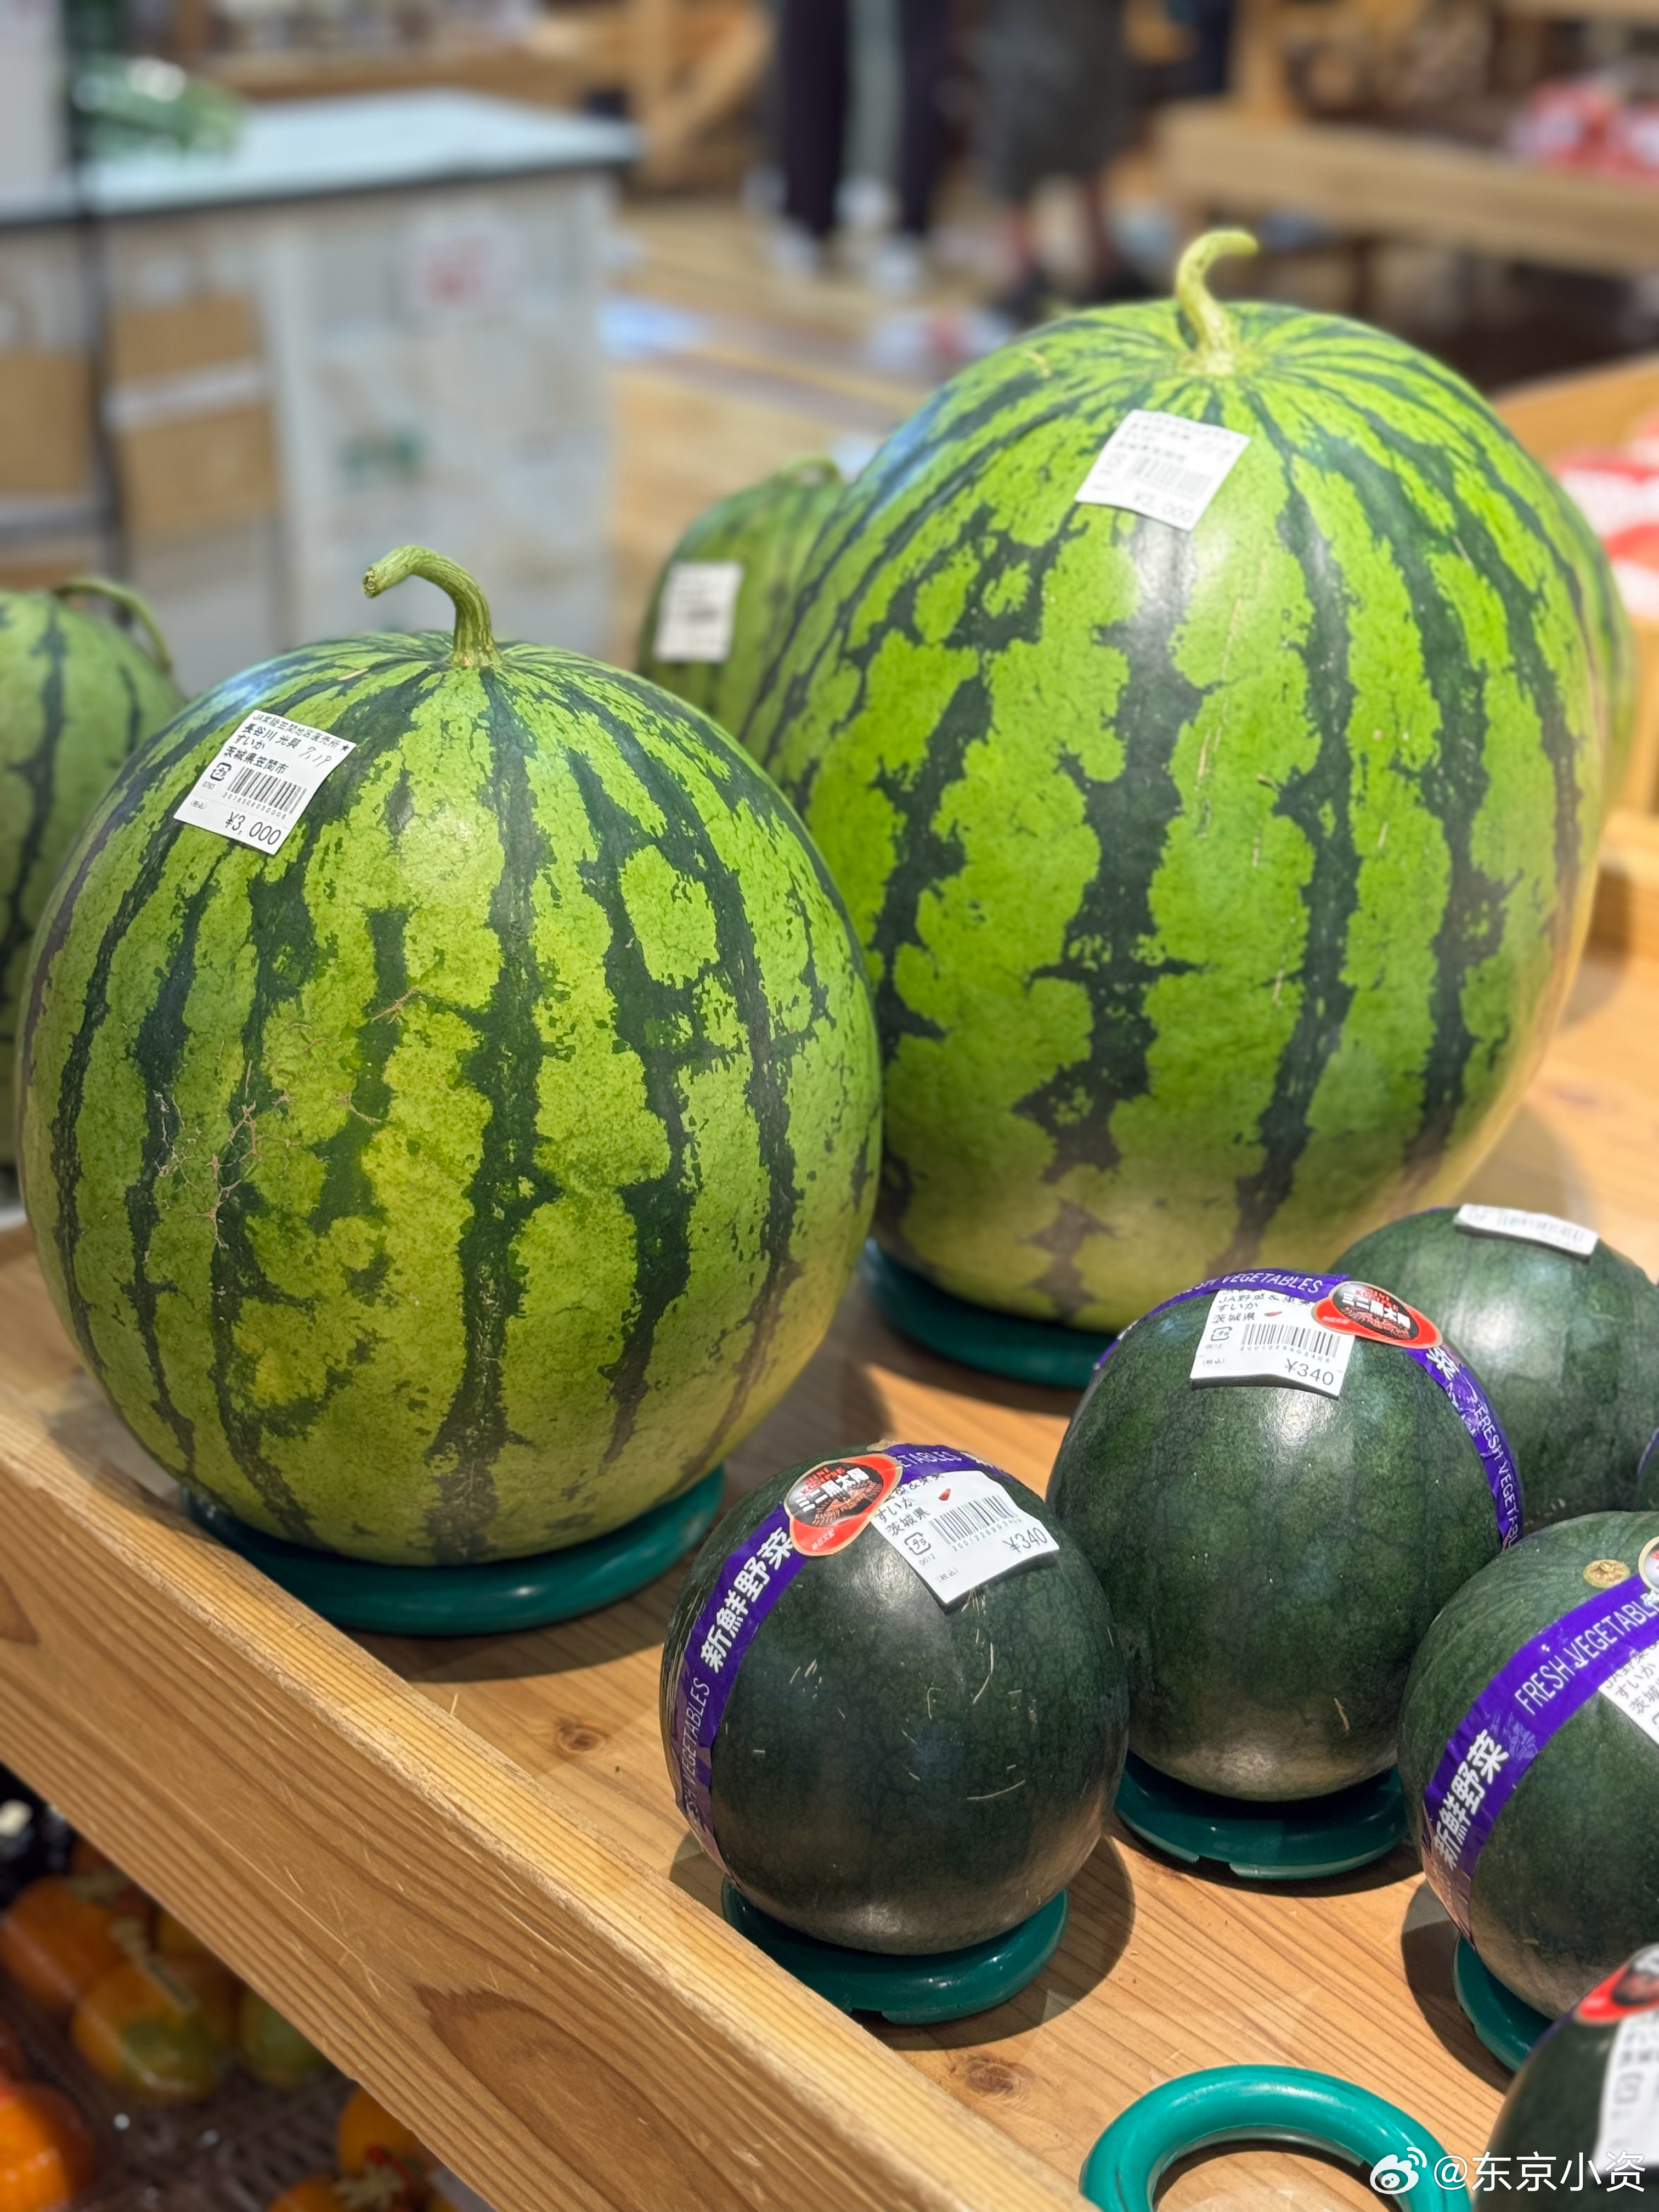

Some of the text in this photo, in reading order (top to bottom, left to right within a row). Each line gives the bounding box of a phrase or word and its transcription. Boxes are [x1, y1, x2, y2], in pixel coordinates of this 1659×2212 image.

[233, 734, 266, 750] すいか
[223, 746, 290, 774] 茨城県笠間市
[224, 811, 281, 845] ¥3,000
[1222, 1272, 1323, 1294] VEGETABLES
[1212, 1312, 1256, 1324] 茨城県
[1217, 1302, 1259, 1312] すいか
[1284, 1358, 1335, 1386] ¥340
[898, 1451, 962, 1468] ETABLES
[795, 1468, 870, 1513] ミニ黒太陽
[1498, 1460, 1519, 1549] VEGETABL
[874, 1497, 915, 1523] すいか
[885, 1507, 931, 1536] 茨城県
[1002, 1526, 1048, 1554] ¥340
[700, 1526, 794, 1673] 新鮮野菜
[1515, 1594, 1659, 1716] FRESH VEGETABL
[1615, 1662, 1656, 1700] すいか
[1629, 1677, 1659, 1716] 茨城
[681, 1678, 710, 1785] VEGETABLES
[1433, 1729, 1510, 1871] 新鮮野菜
